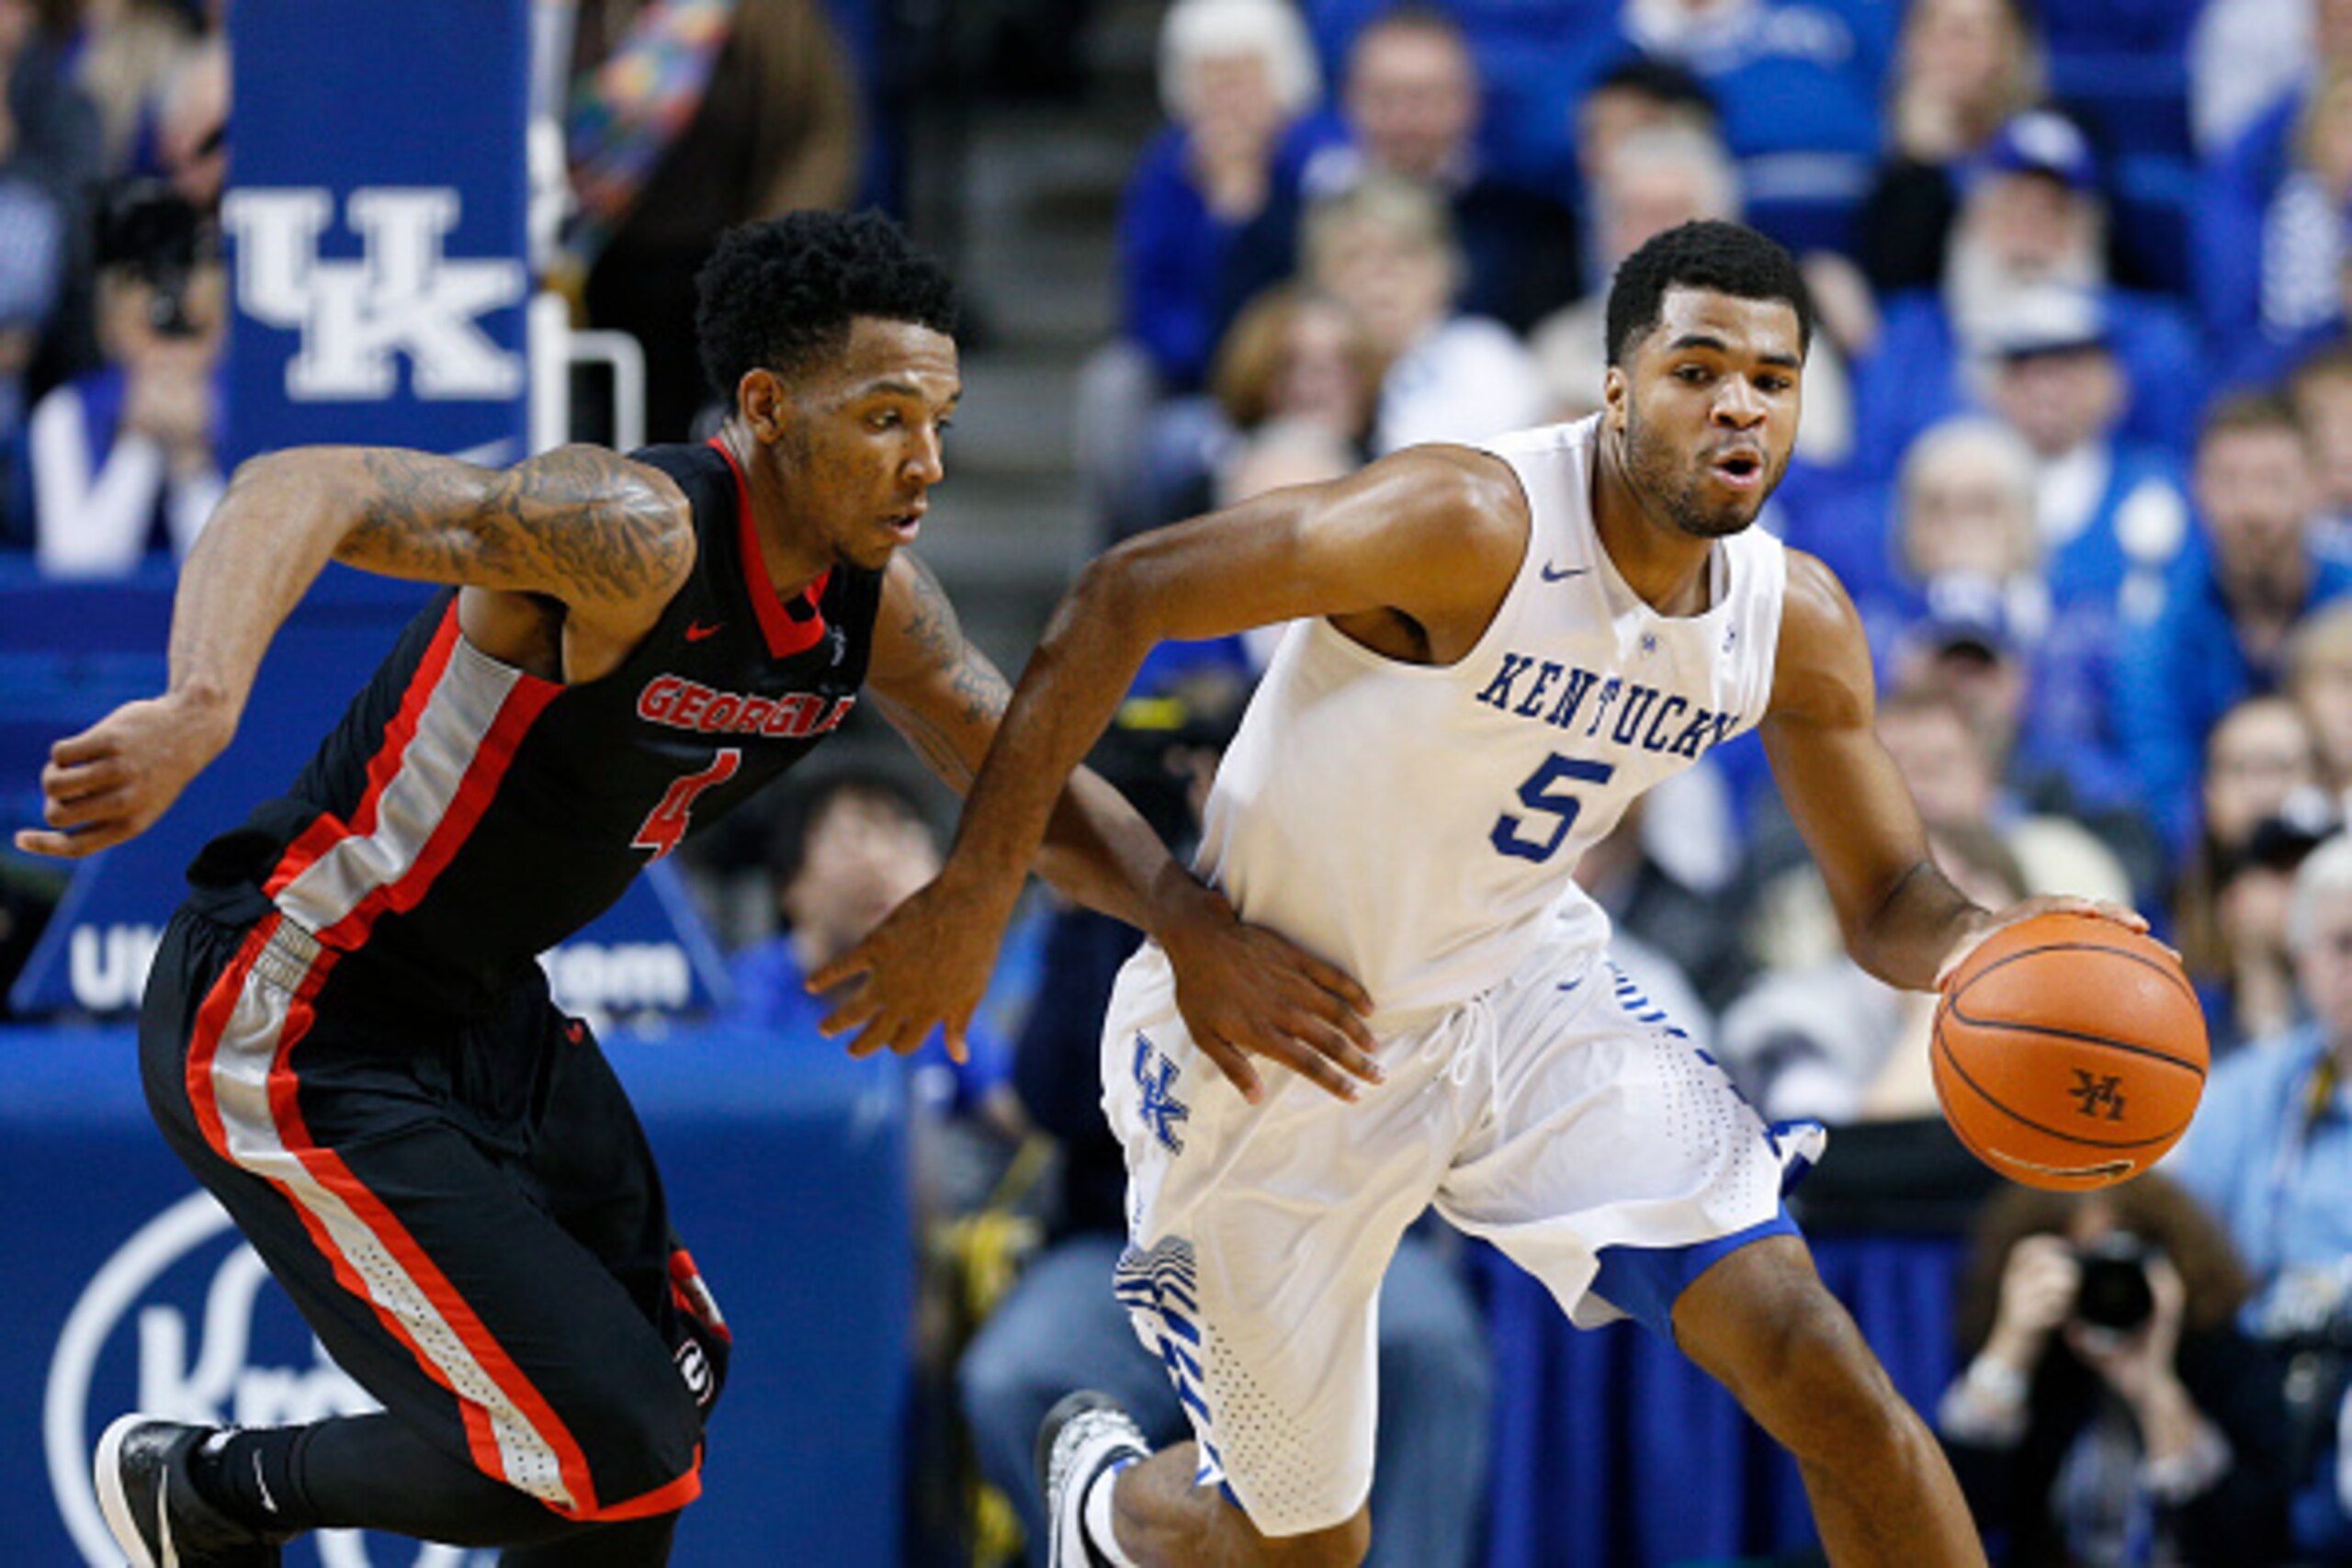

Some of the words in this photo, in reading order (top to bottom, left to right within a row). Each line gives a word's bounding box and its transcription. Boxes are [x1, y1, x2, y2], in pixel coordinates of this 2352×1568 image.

[220, 187, 526, 401] UK
[637, 673, 856, 737] GEORGIA
[1476, 652, 1739, 759] KENTUCKY
[630, 748, 742, 867] 4
[1489, 750, 1617, 865] 5
[1133, 1029, 1191, 1156] UK
